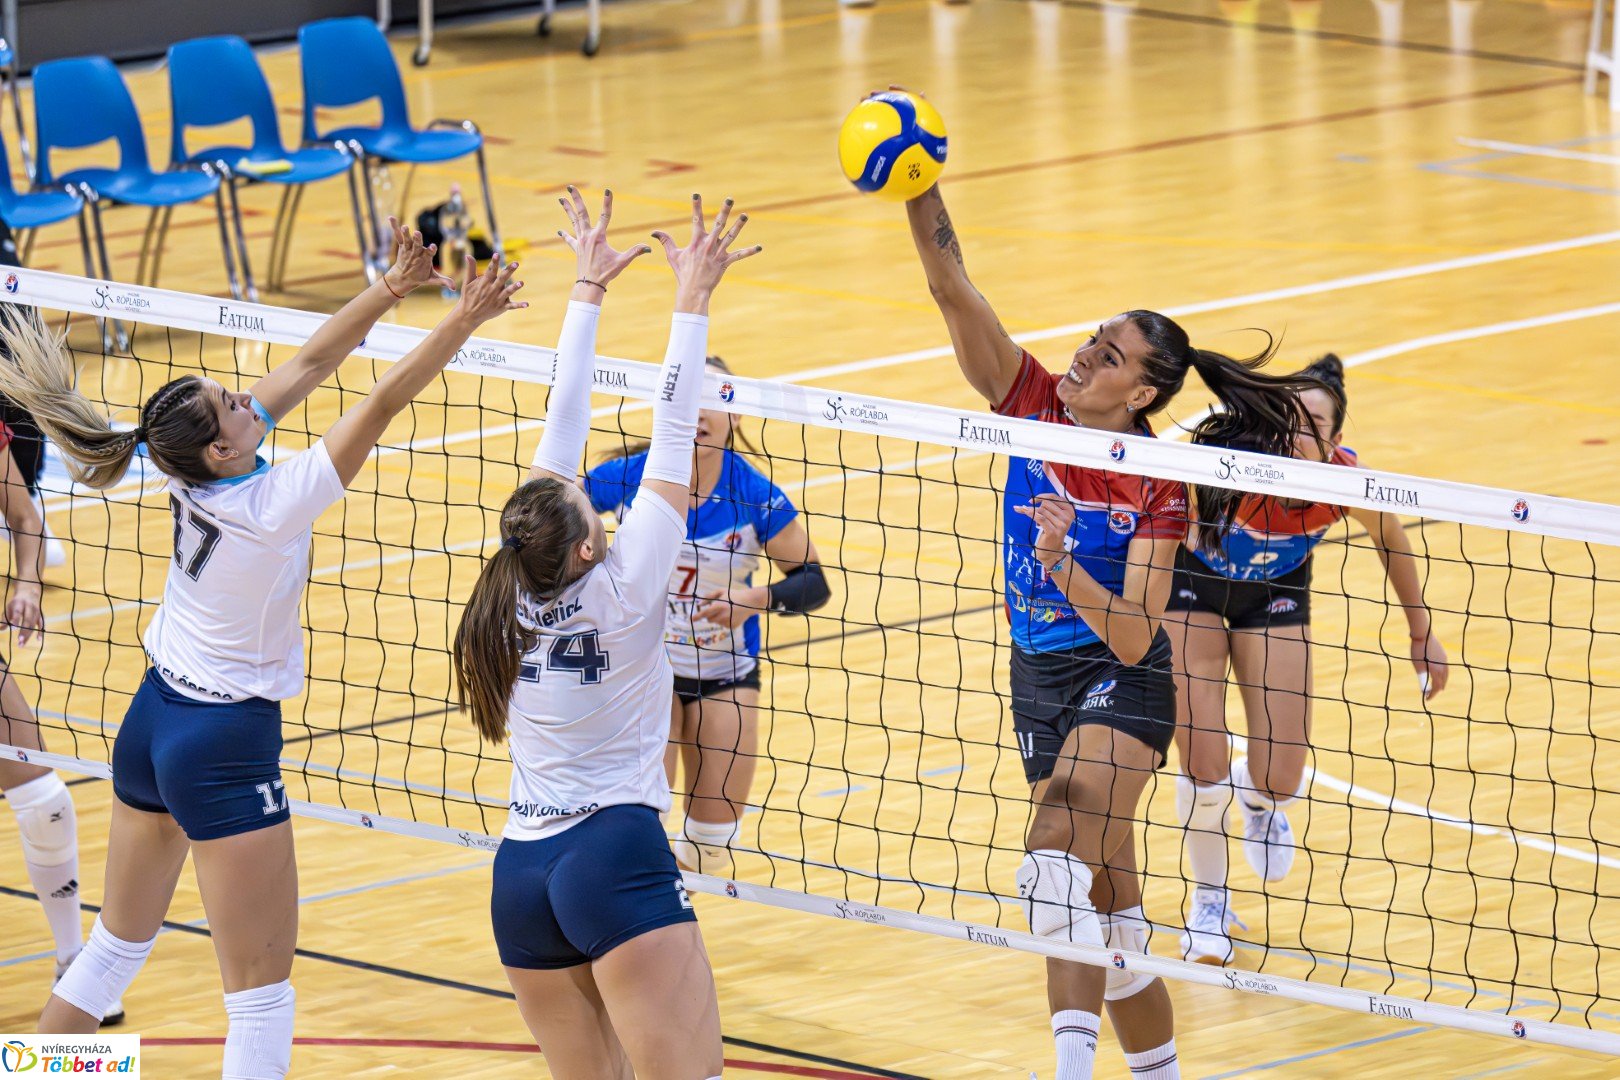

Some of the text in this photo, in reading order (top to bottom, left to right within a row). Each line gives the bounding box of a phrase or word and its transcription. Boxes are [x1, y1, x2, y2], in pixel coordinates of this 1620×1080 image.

[959, 417, 1011, 445] FATUM
[1244, 466, 1285, 480] RÖPLABDA
[1364, 477, 1419, 506] FATUM
[676, 566, 701, 595] 7
[256, 779, 287, 815] 17
